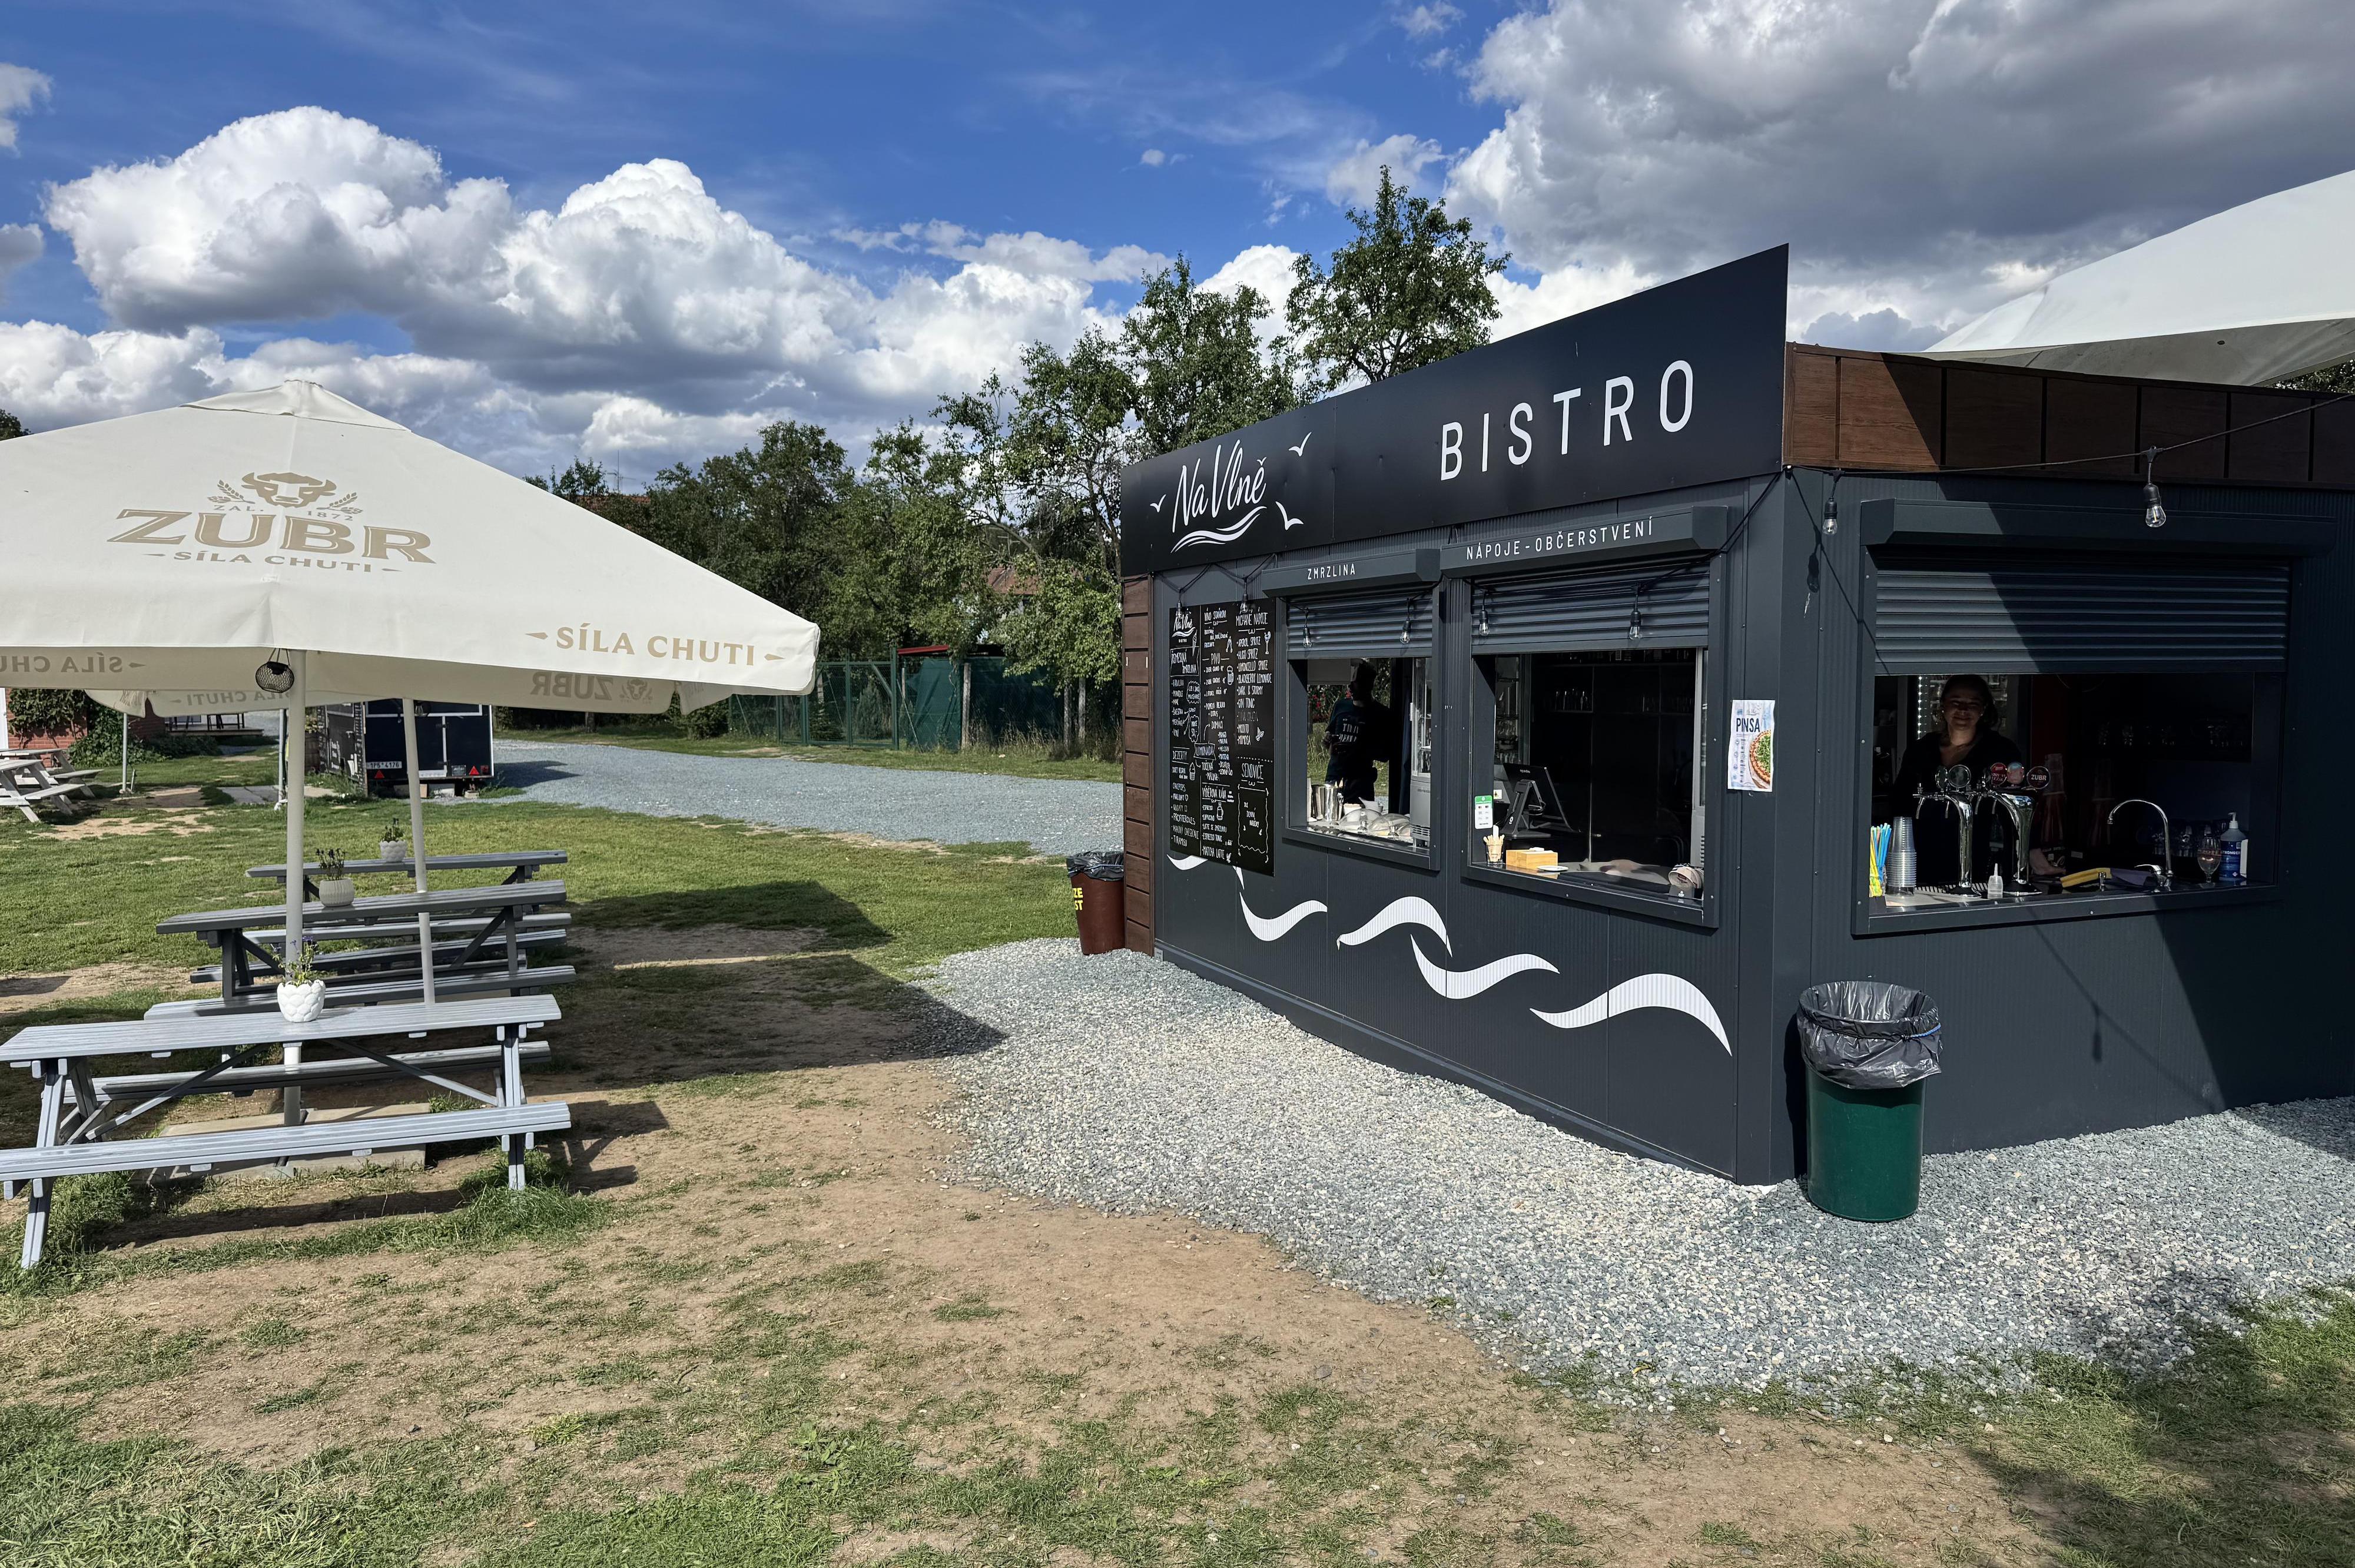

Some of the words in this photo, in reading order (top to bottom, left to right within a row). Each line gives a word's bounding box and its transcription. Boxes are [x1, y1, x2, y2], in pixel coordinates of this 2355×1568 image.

[1441, 360, 1693, 481] BISTRO
[1172, 458, 1209, 533] Na
[1212, 439, 1267, 518] Vlně
[213, 504, 264, 513] ZAL.
[306, 510, 354, 521] 1872
[106, 508, 437, 565] ZUBR
[174, 550, 253, 564] SÍLA
[264, 555, 372, 573] CHUTI
[1307, 562, 1356, 580] ZMRZLINA
[556, 622, 635, 655] SÍLA
[647, 635, 755, 667] CHUTI
[1210, 652, 1220, 665] PIVO
[1736, 717, 1760, 732] PINSA
